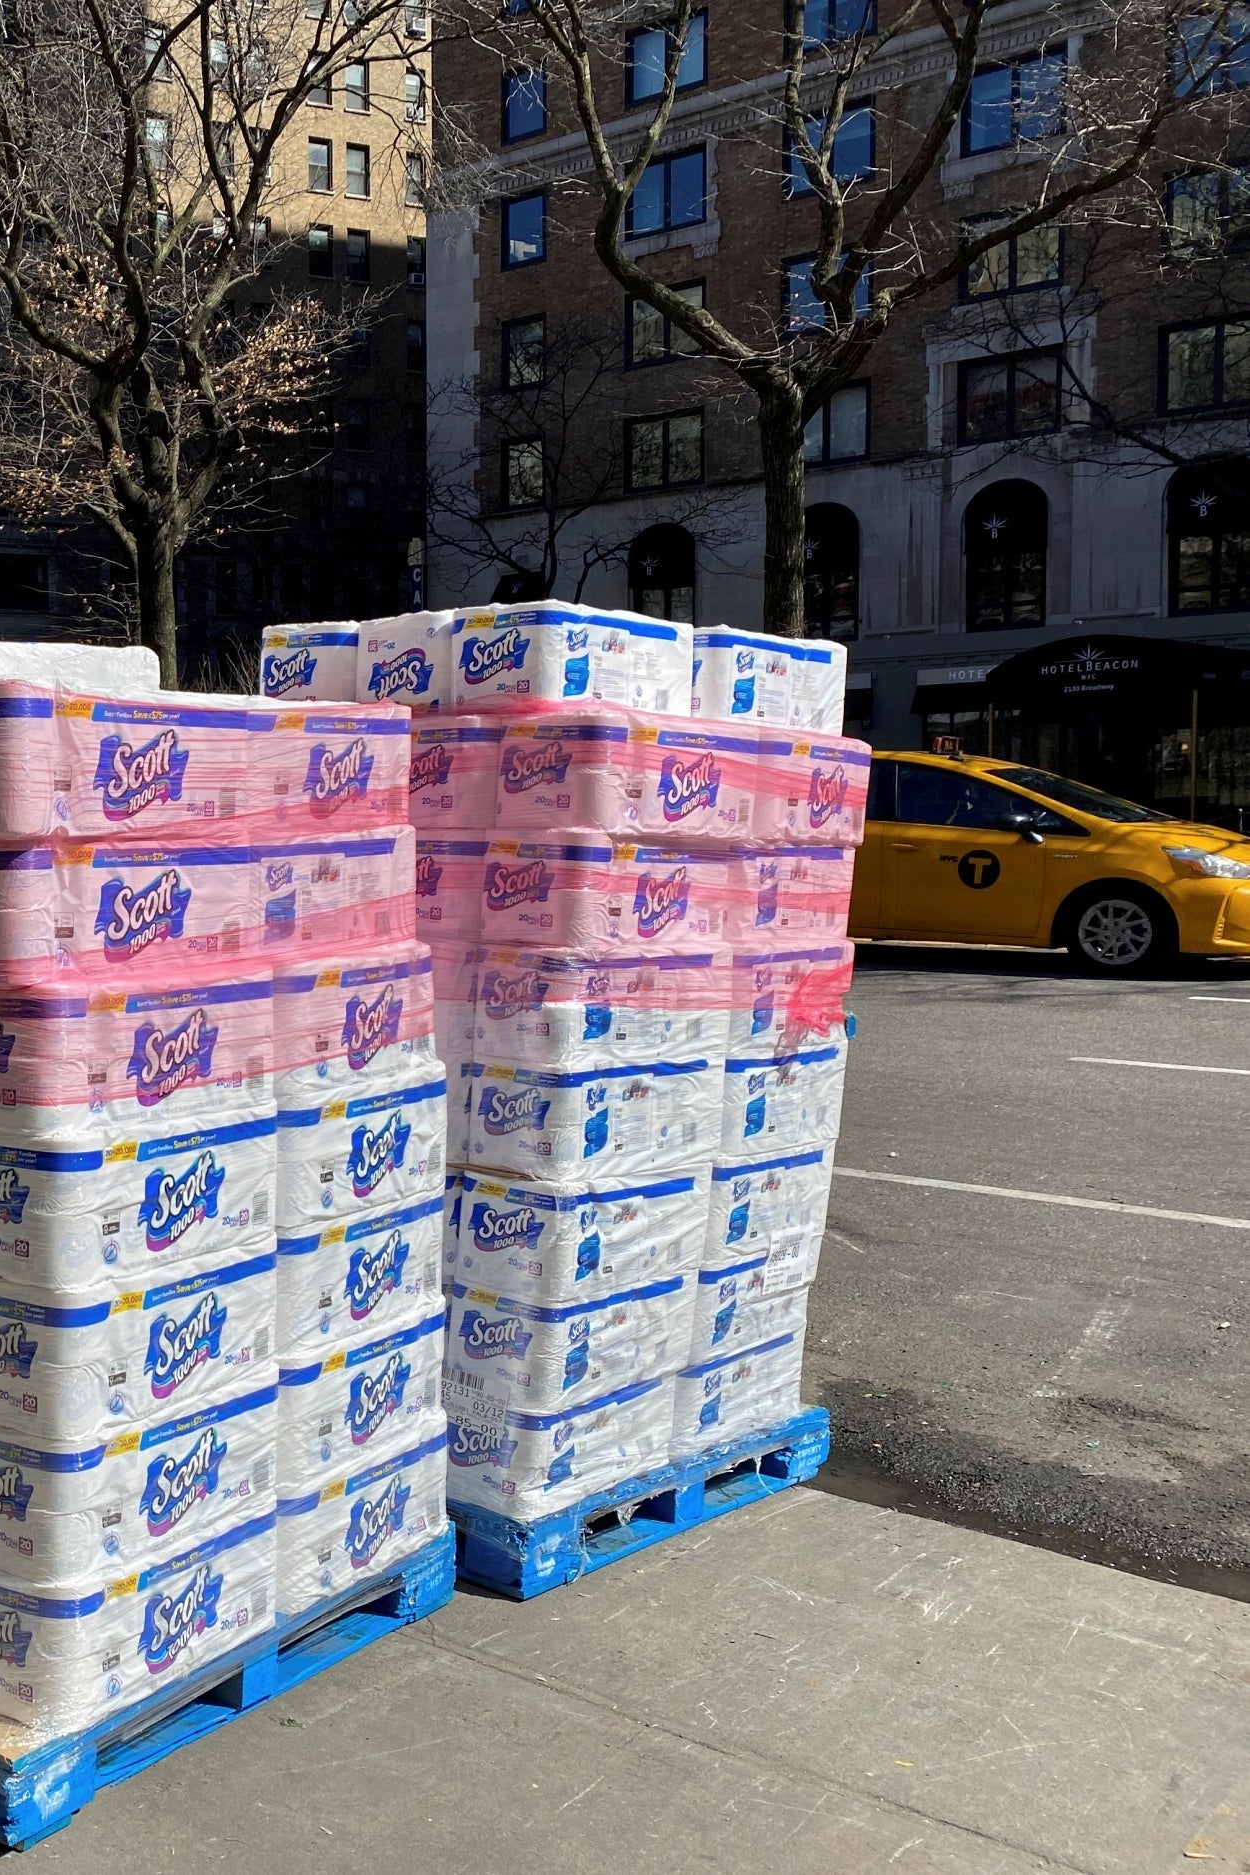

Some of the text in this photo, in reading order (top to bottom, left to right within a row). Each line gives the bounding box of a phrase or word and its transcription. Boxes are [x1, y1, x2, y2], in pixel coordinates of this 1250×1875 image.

[390, 653, 409, 671] 1000
[470, 629, 519, 671] Scott
[1041, 659, 1139, 674] HOTEL BEACON
[268, 650, 309, 686] Scott
[278, 678, 295, 692] 1000
[377, 660, 420, 700] Scott
[483, 661, 503, 679] 1000
[949, 669, 990, 680] HOTE
[108, 729, 175, 798] Scott
[316, 738, 365, 799] Scott
[410, 745, 442, 778] cott
[509, 742, 560, 780] Scott
[668, 752, 714, 804] Scott
[128, 784, 155, 814] 1000
[522, 773, 543, 790] 1000
[814, 766, 844, 812] Scott
[681, 798, 699, 816] 1000
[490, 861, 544, 898] Scott
[939, 854, 992, 884] NYC T
[107, 870, 177, 941] Scott
[505, 892, 527, 907] 1000
[642, 867, 687, 920] Scott
[129, 923, 156, 954] 1000
[490, 971, 540, 1007] Scott
[351, 985, 393, 1050] Scott
[141, 1010, 204, 1084] Scott
[158, 1065, 186, 1096] 1000
[488, 1088, 540, 1122] Scott
[503, 1119, 524, 1133] 1000
[150, 1151, 213, 1229] Scott
[170, 1207, 195, 1241] 1000
[479, 1208, 534, 1238] Scott
[493, 1236, 515, 1249] 1000
[354, 1230, 400, 1300] Scott
[155, 1293, 215, 1376] Scott
[469, 1318, 521, 1346] Scott
[172, 1349, 198, 1384] 1000
[483, 1345, 503, 1357] 1000
[355, 1352, 400, 1425] Scott
[473, 1402, 504, 1418] 03/12
[152, 1428, 214, 1515] Scott
[468, 1452, 489, 1464] 1000
[169, 1485, 195, 1523] 1000
[354, 1476, 400, 1550] Scott
[150, 1566, 209, 1652] Scott
